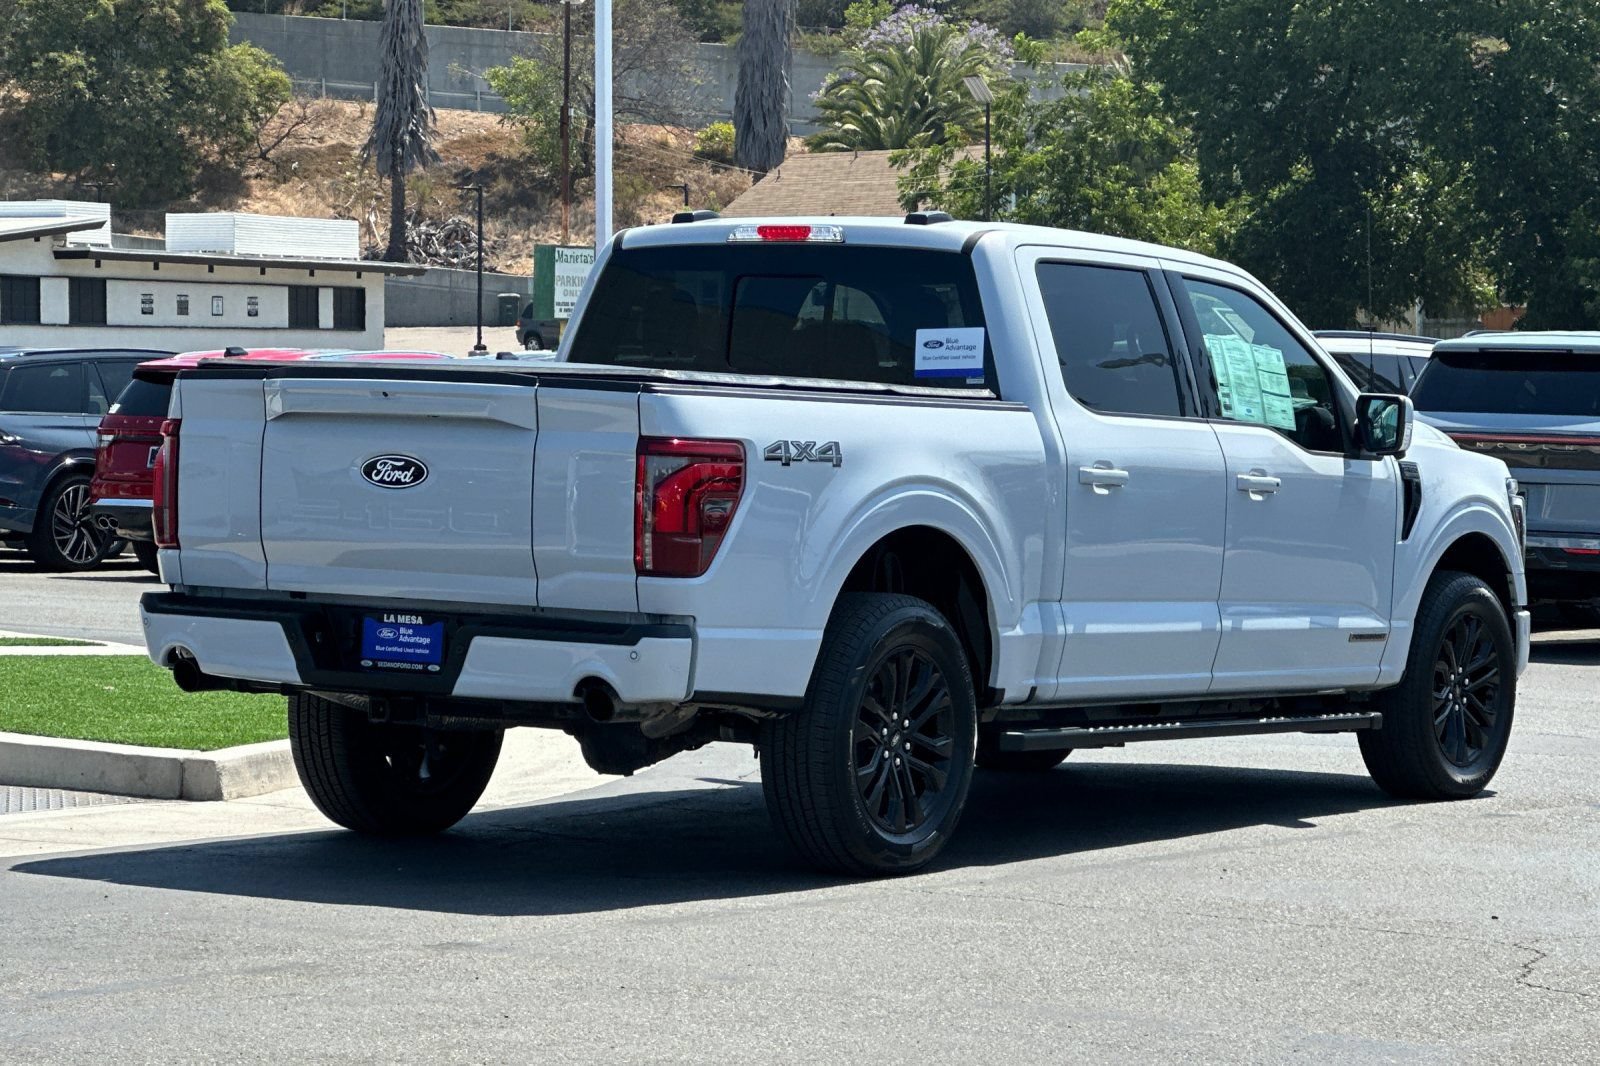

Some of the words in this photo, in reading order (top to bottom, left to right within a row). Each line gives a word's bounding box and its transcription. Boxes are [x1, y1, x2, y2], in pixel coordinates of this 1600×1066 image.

[555, 250, 594, 264] Marieta's
[555, 275, 587, 288] PARKIN
[563, 289, 580, 297] ONL
[371, 459, 414, 483] Ford
[383, 613, 396, 623] LA
[397, 614, 423, 624] MESA
[398, 635, 431, 644] Advantage
